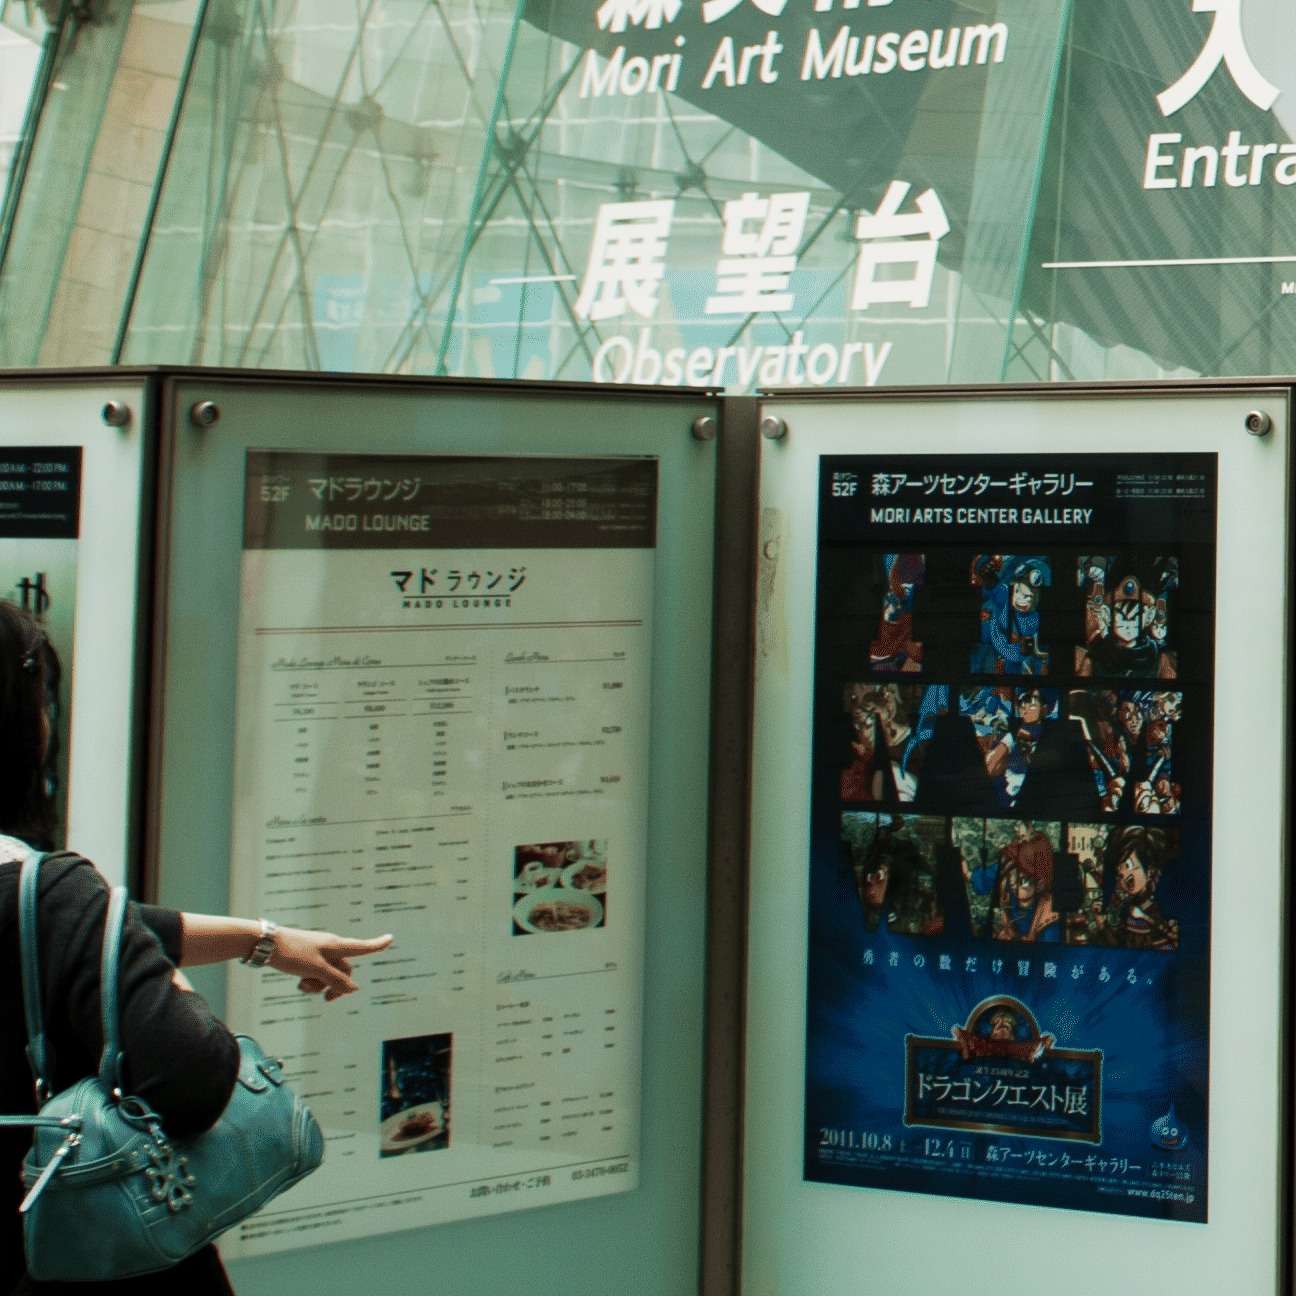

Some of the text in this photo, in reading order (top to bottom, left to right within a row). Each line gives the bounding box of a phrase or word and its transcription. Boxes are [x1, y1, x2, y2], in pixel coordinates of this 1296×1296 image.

[579, 20, 1008, 98] Mori Art Museum
[575, 179, 951, 321] 展望台
[592, 330, 892, 390] Observatory
[308, 477, 421, 501] マドラウンジ
[832, 482, 858, 496] 52F
[872, 472, 1093, 496] 森アーツセンターギャラリー
[305, 514, 431, 532] MADO LOUNGE
[870, 508, 1093, 524] MORI ARTS CENTER GALLERY
[402, 599, 511, 609] MADO LOUNGE
[918, 1072, 1088, 1116] ドラゴンクエスト展
[985, 1144, 1143, 1174] 森アーツセンターギャラリー
